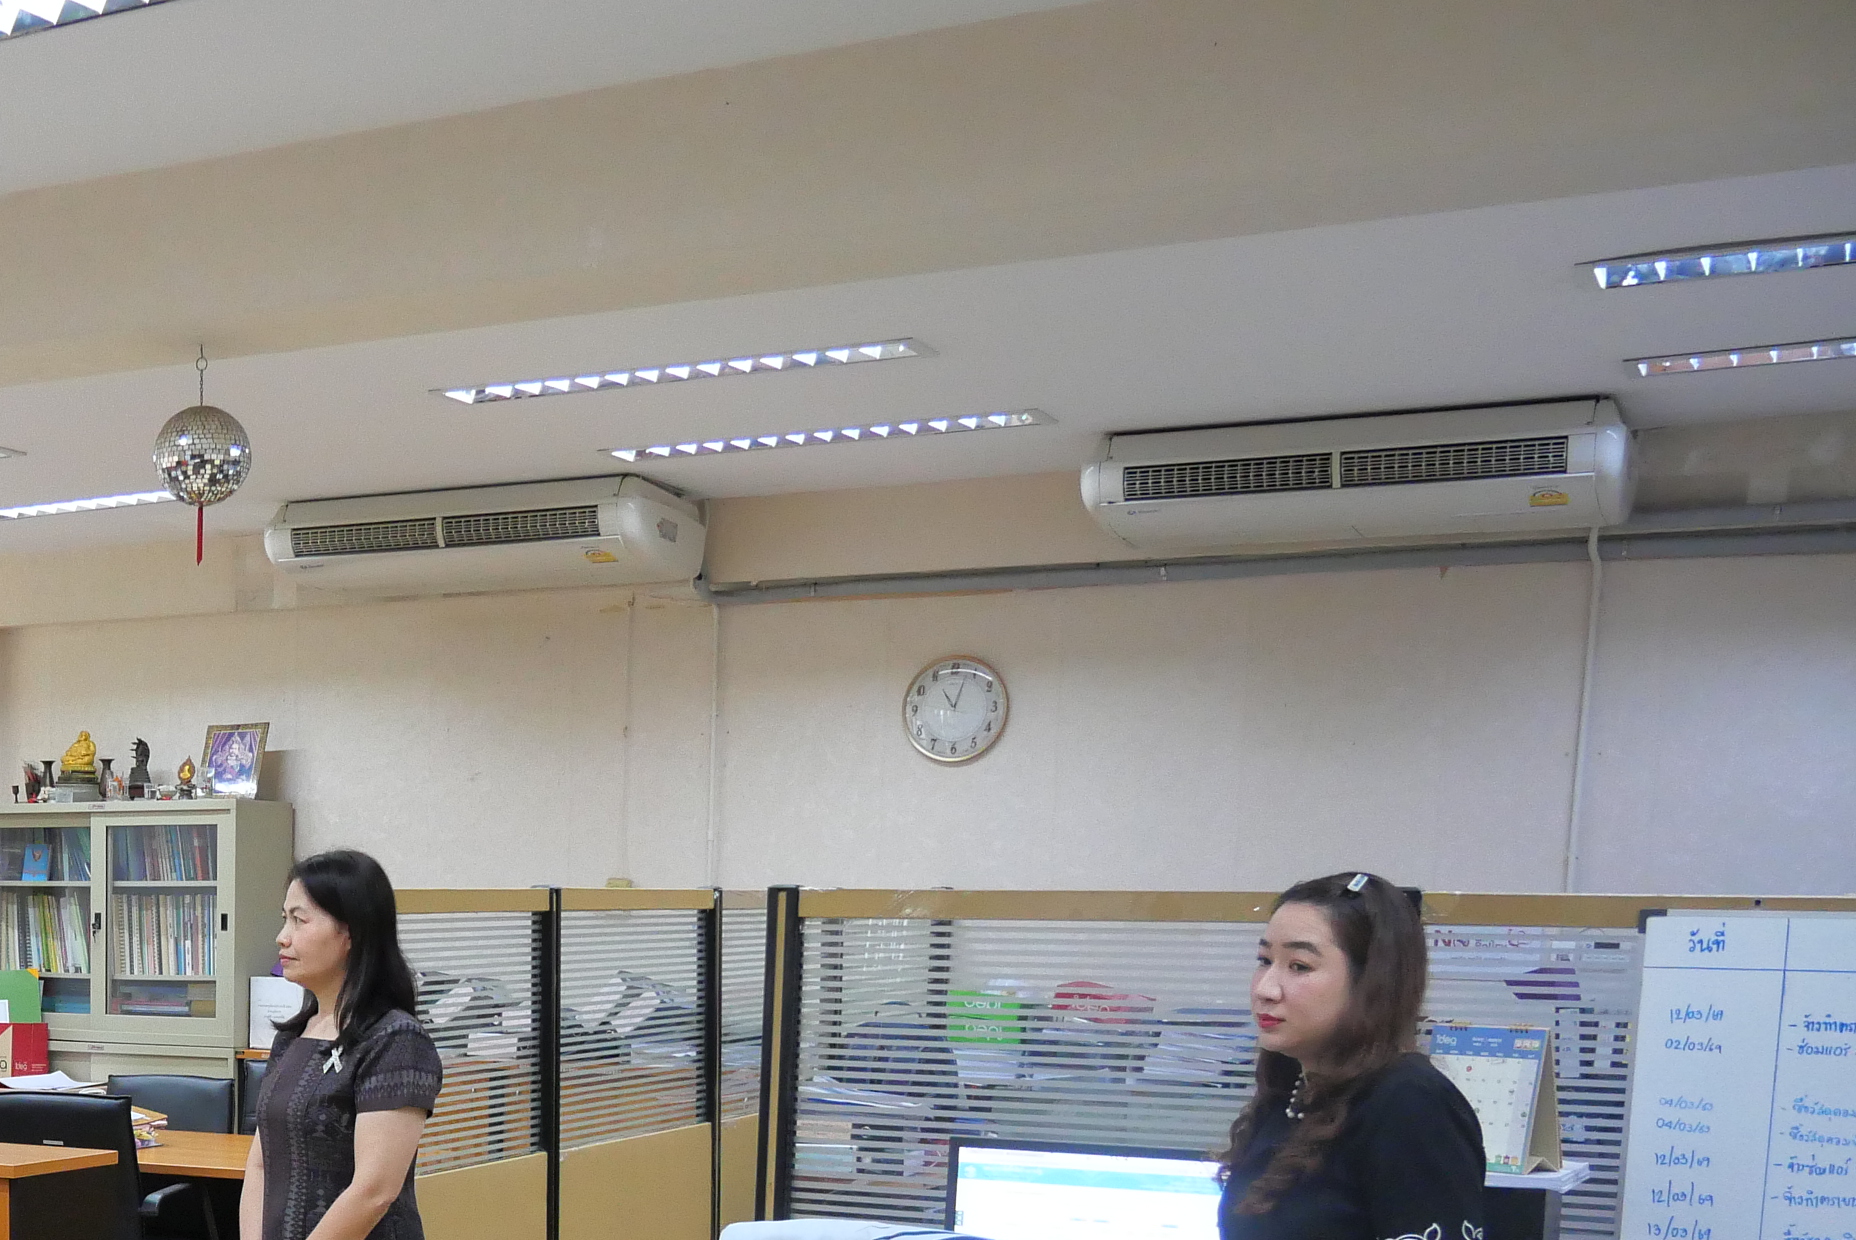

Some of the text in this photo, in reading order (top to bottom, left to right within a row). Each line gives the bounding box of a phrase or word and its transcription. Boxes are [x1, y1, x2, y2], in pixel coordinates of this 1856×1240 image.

[911, 704, 918, 716] 9
[991, 700, 998, 712] 3
[917, 724, 923, 737] 8
[984, 720, 991, 732] 4
[931, 738, 938, 751] 7
[950, 742, 957, 755] 6
[970, 736, 977, 749] 5
[1689, 922, 1726, 953] วันที่
[1655, 1146, 1710, 1169] 12/03/69
[1652, 1180, 1714, 1207] 12/03/69
